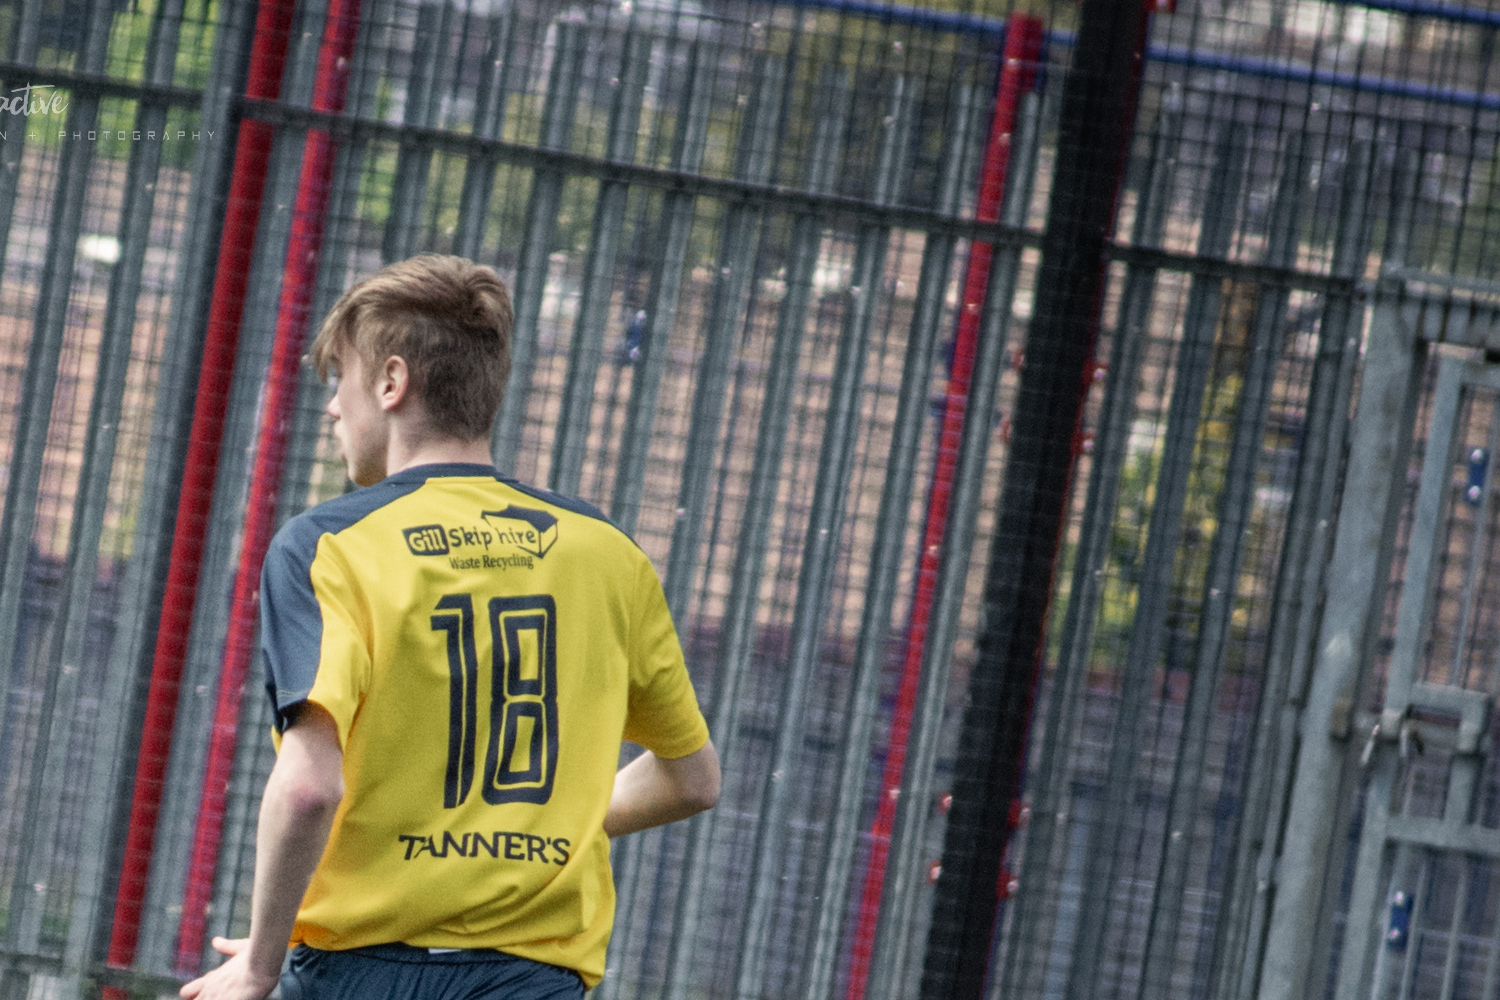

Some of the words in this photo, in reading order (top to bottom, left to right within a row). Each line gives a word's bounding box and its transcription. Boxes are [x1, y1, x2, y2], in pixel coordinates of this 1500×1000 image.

[408, 528, 447, 552] Gill
[450, 527, 492, 550] Skip
[495, 526, 537, 545] hire
[449, 556, 480, 570] Waste
[482, 553, 534, 571] Recycling
[430, 593, 559, 810] 18
[398, 830, 570, 866] TANNER'S
